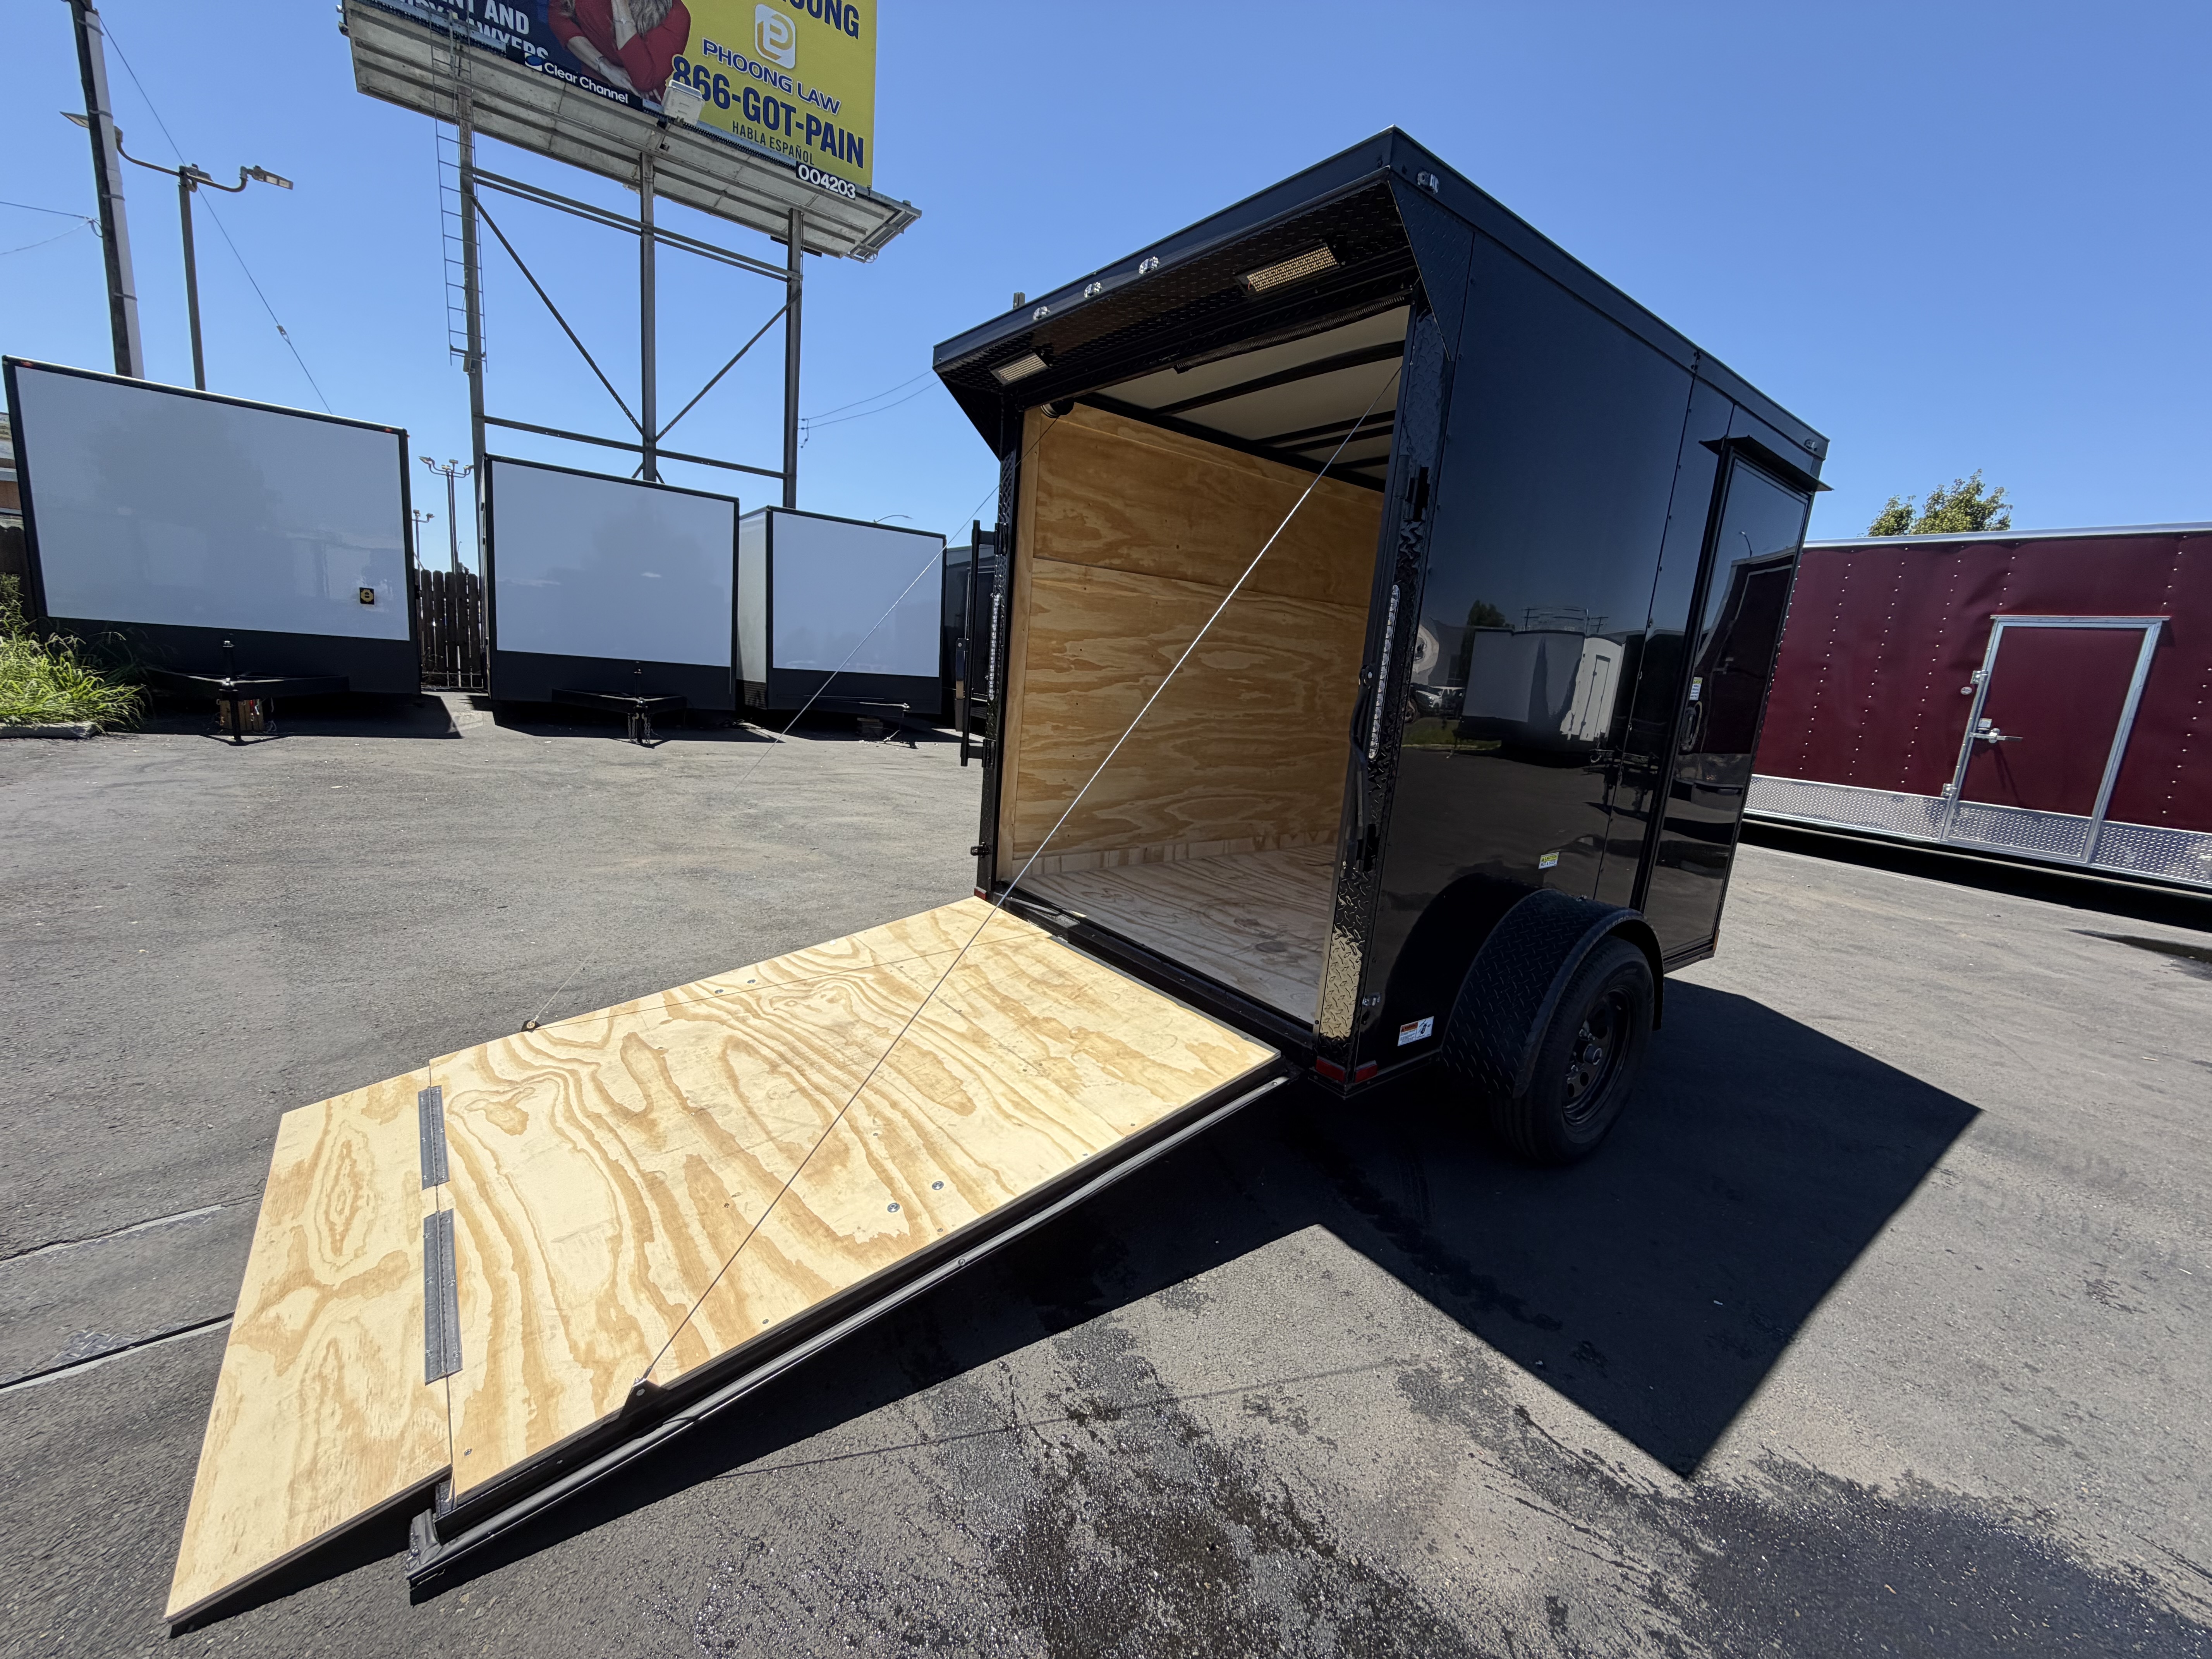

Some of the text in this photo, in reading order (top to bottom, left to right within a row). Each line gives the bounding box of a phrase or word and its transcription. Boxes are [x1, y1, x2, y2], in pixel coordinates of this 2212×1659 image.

[484, 0, 529, 35] AND
[544, 62, 628, 104] Clear Channel
[703, 38, 840, 114] PHOONG LAW
[673, 56, 864, 168] 866-GOT-PAIN
[733, 120, 814, 165] HABLA ESPAÑOL
[798, 164, 855, 199] 004203
